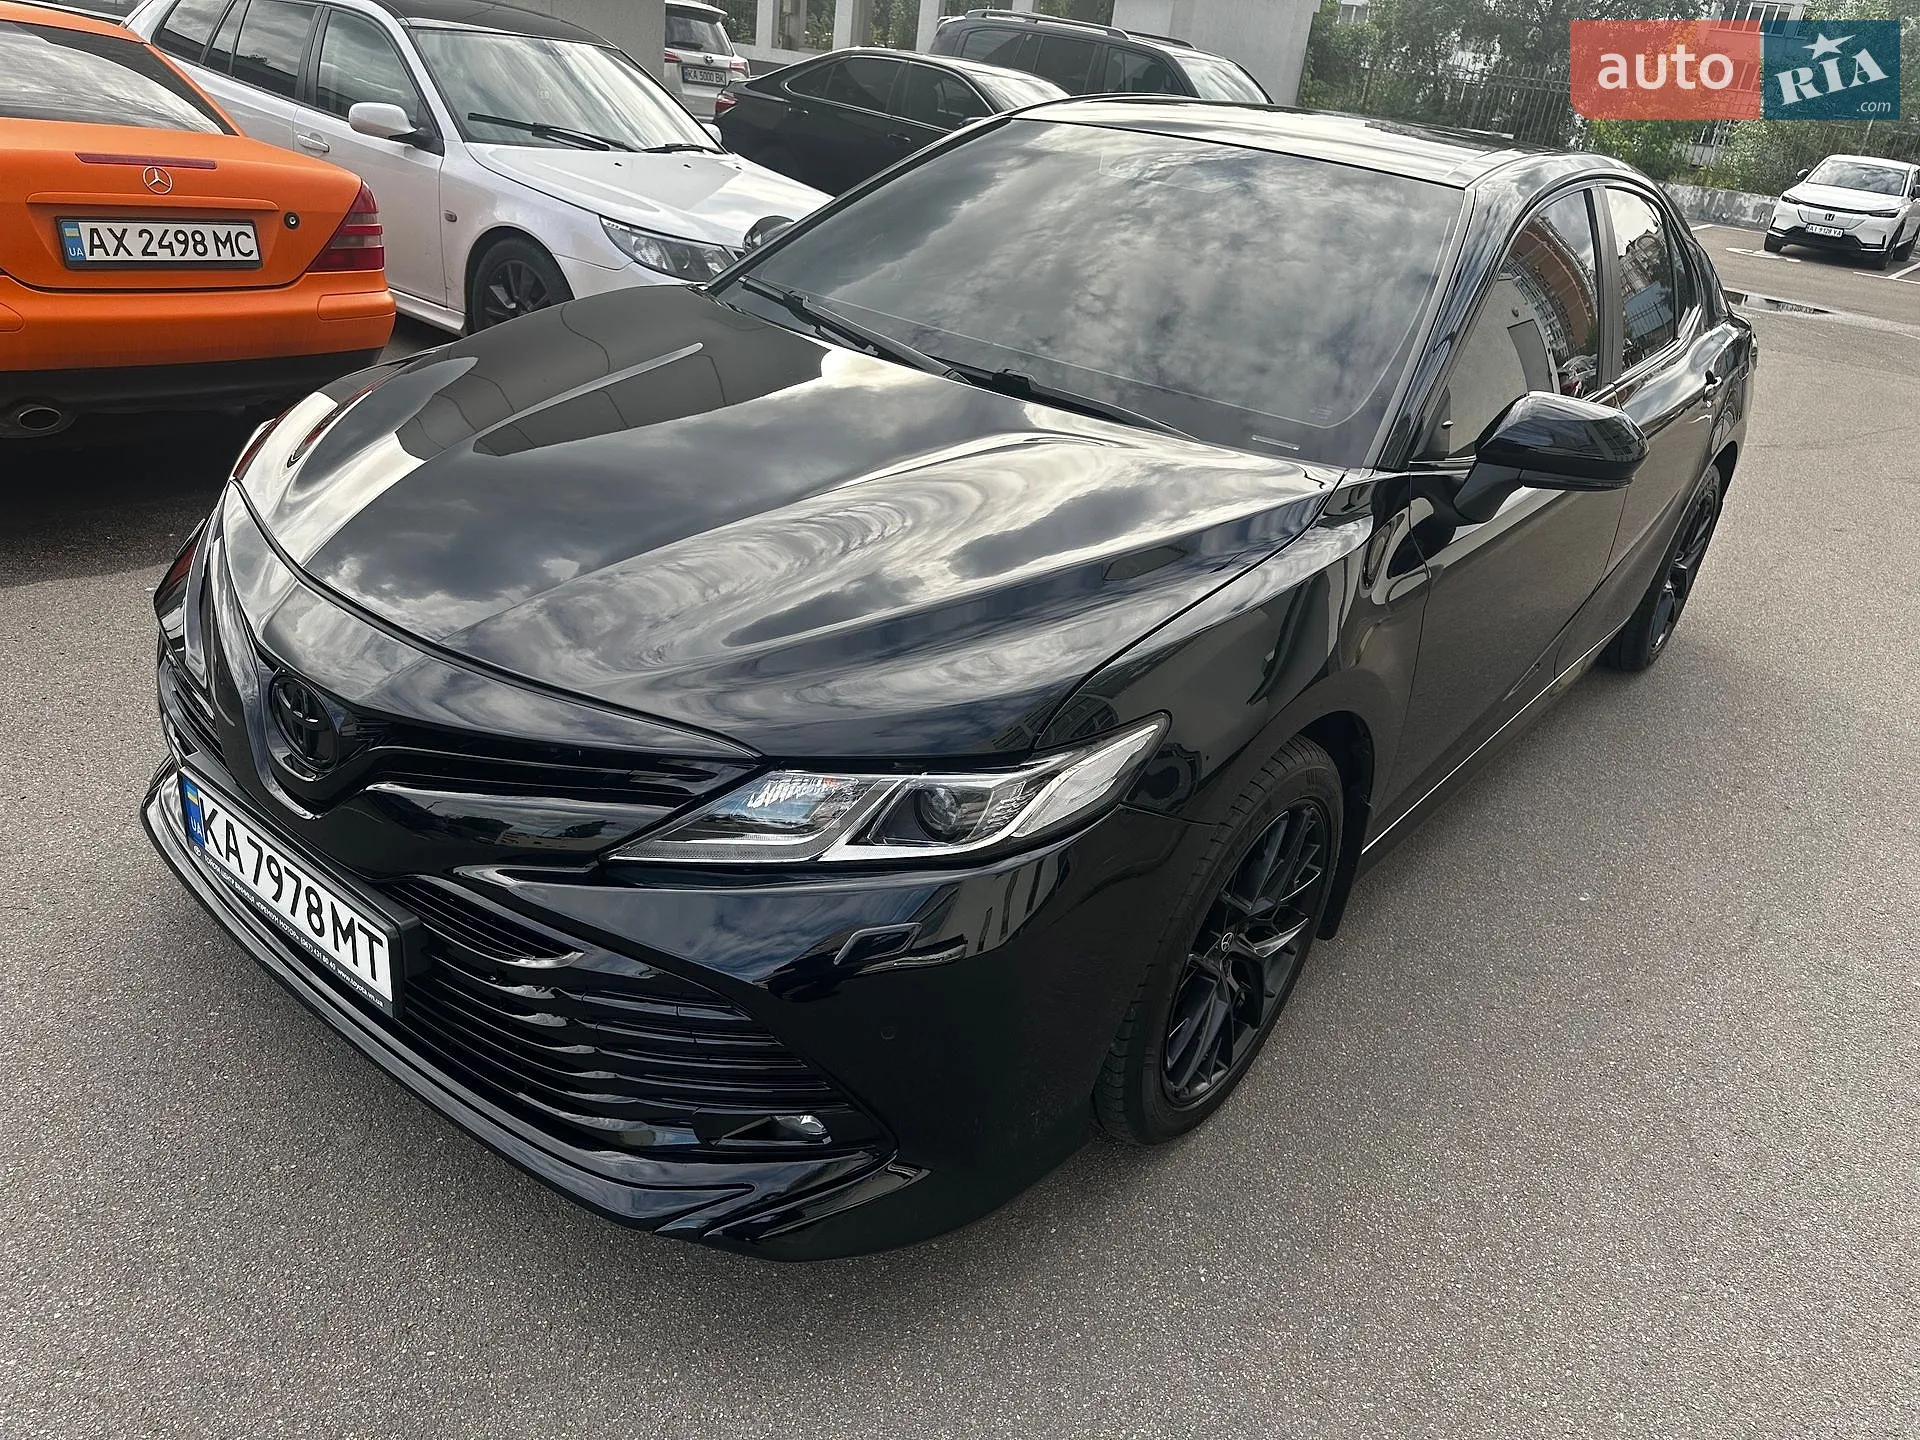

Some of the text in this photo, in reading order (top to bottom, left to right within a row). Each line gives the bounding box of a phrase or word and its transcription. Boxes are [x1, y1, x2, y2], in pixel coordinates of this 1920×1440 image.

[68, 247, 84, 256] UA
[89, 228, 254, 257] AX 2498 MC
[190, 817, 203, 837] UA
[200, 797, 384, 981] KA 7978 MT
